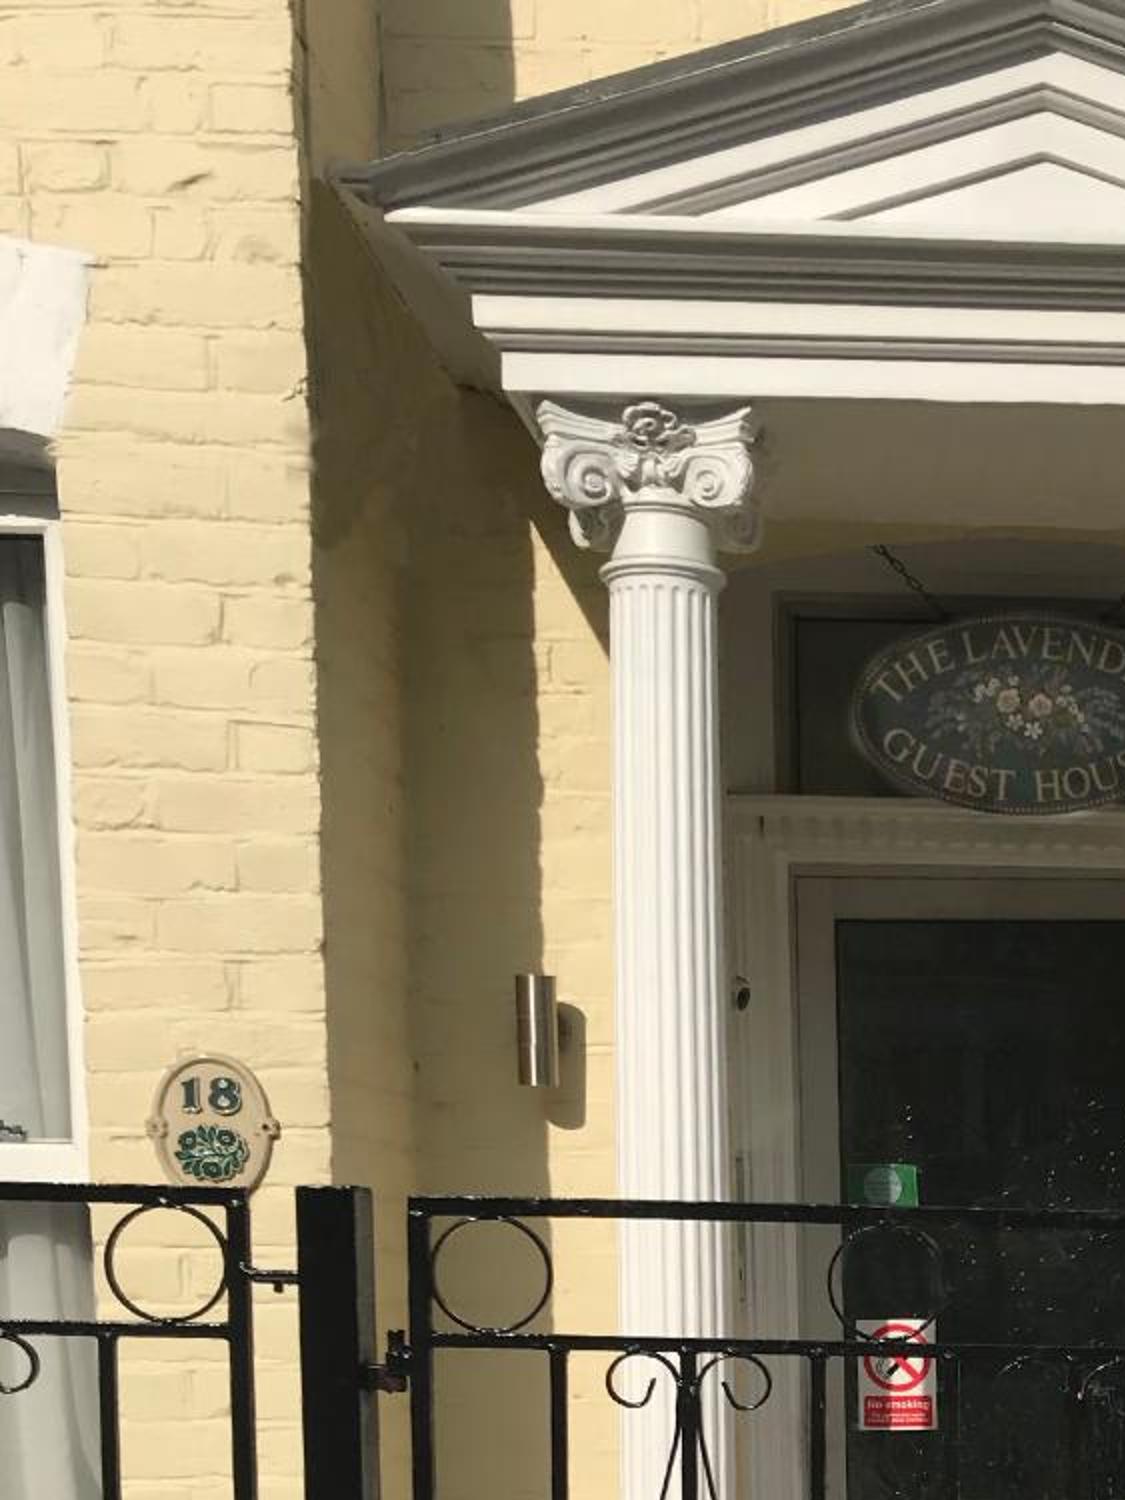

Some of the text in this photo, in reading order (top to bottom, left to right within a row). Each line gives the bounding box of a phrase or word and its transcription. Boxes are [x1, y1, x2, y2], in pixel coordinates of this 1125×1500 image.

[871, 638, 956, 702] THE
[883, 728, 1016, 801] GUEST
[180, 1077, 243, 1116] 18
